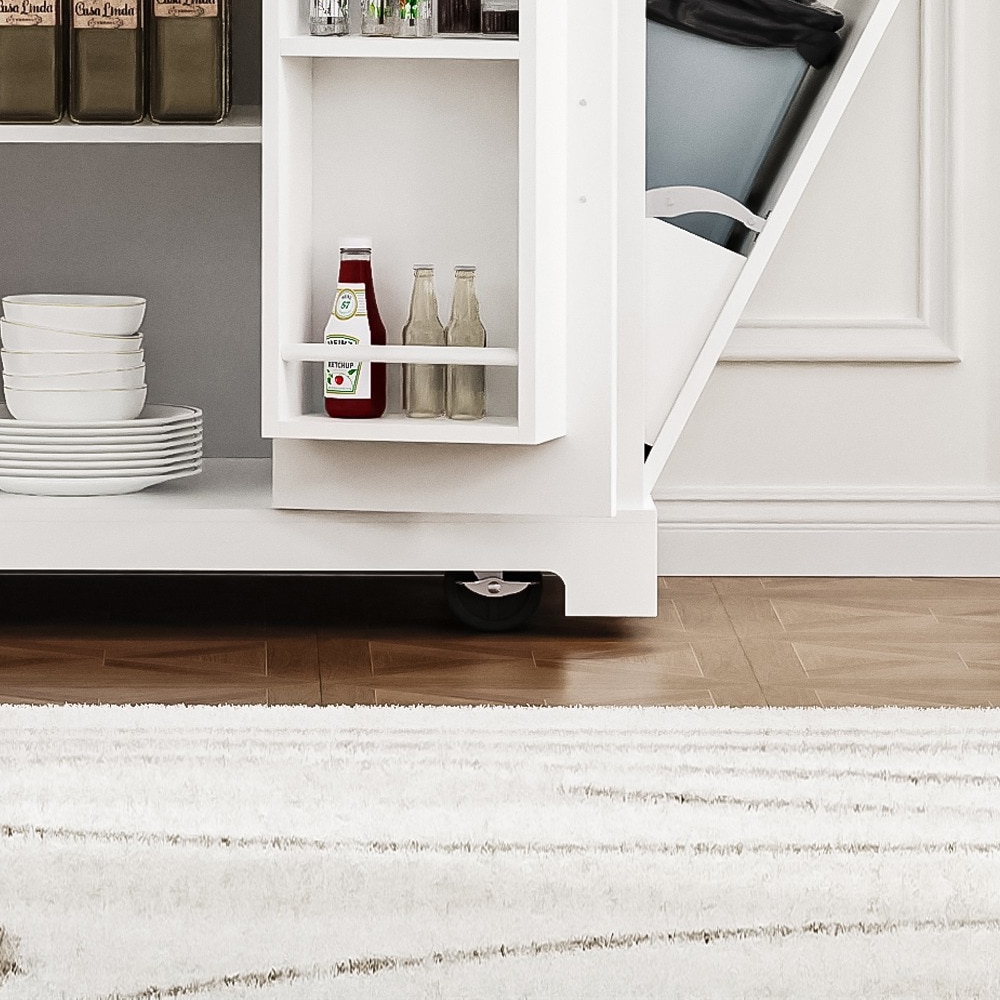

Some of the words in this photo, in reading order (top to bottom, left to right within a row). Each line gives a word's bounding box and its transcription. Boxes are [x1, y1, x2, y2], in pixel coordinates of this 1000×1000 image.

[20, 0, 53, 14] Linda
[102, 2, 135, 18] Linda
[340, 301, 351, 310] 57
